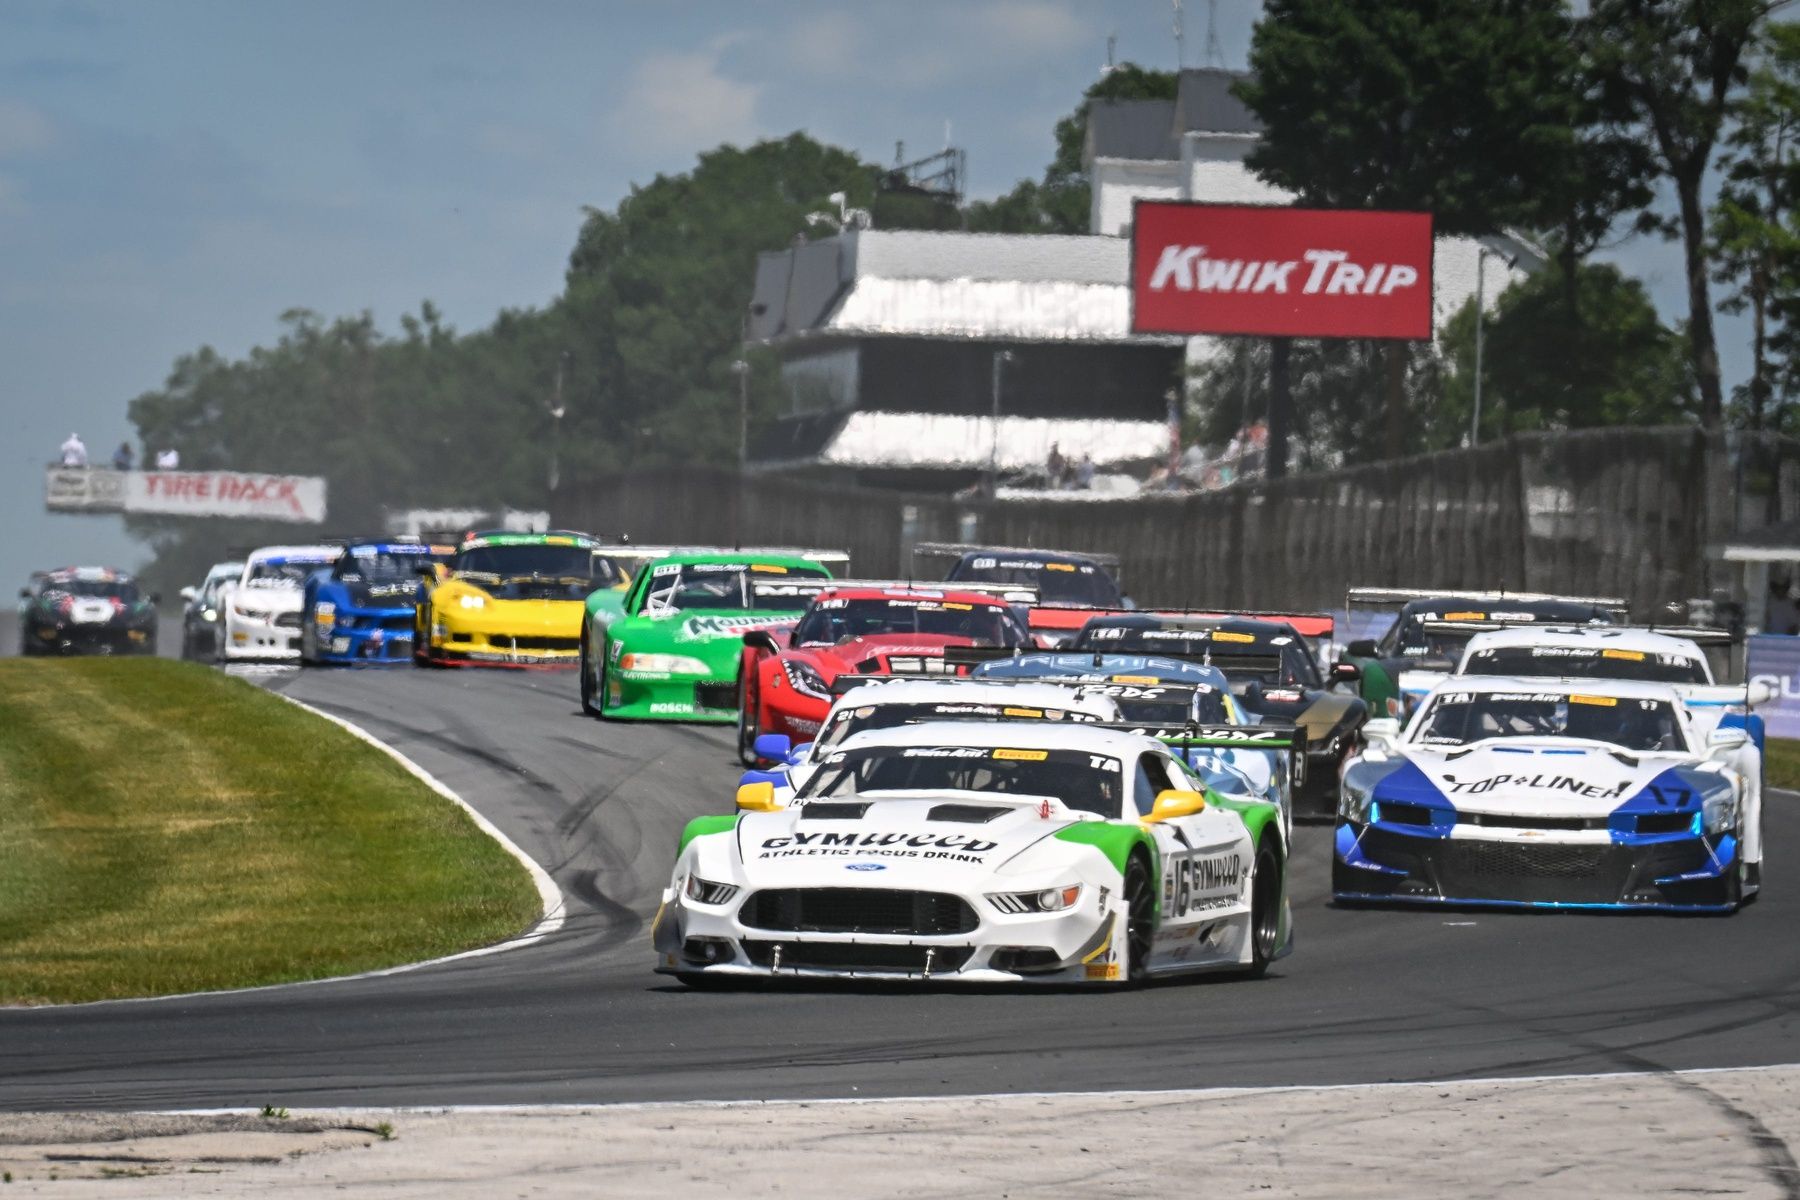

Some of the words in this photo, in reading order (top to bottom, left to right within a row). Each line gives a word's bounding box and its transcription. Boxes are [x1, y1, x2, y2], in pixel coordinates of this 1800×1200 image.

[1149, 244, 1298, 294] KWIK
[1302, 249, 1419, 295] TRIP
[146, 475, 210, 498] TIRE
[650, 702, 694, 714] BOSCH
[836, 709, 855, 722] 21
[1089, 755, 1120, 772] TA
[1648, 785, 1692, 807] 17
[758, 848, 850, 859] ATHLETIC
[856, 848, 918, 858] FOCUS
[923, 851, 985, 865] DRINK
[1172, 859, 1190, 918] 16
